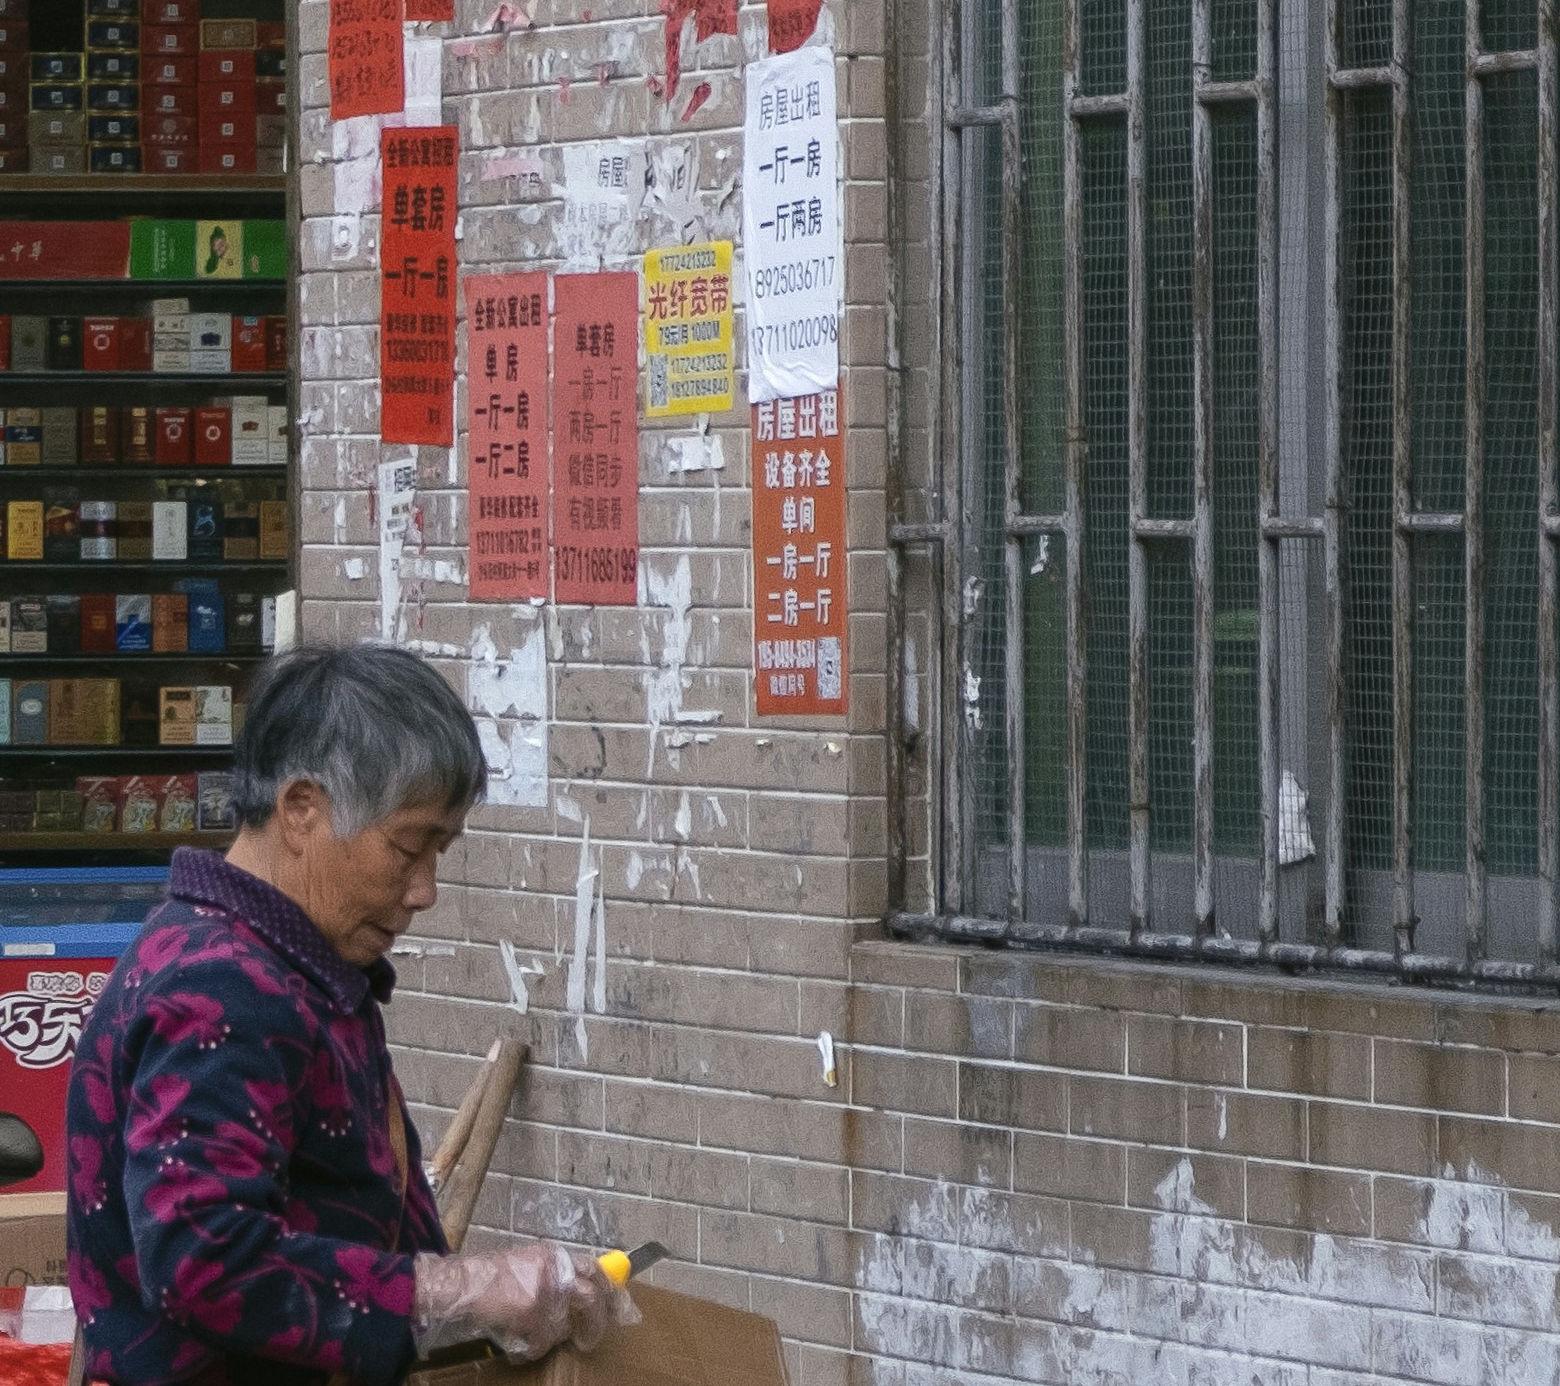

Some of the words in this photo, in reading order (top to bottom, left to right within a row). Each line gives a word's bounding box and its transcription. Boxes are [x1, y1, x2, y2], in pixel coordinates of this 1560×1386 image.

[760, 80, 821, 130] 房屋出租
[759, 137, 821, 185] 一厅一房
[760, 196, 821, 243] 一厅两房
[385, 256, 448, 299] 一厅一房
[648, 273, 729, 321] 光纤宽带
[568, 366, 622, 401] 一房一厅
[475, 389, 530, 431] 一厅一房
[568, 410, 622, 445] 两房一厅
[757, 390, 839, 441] 房屋出租
[475, 440, 530, 480] 一厅二房
[764, 449, 832, 489] 设备齐全
[782, 496, 815, 534] 单间
[766, 541, 832, 581] 一房一厅
[767, 588, 832, 627] 二房一厅
